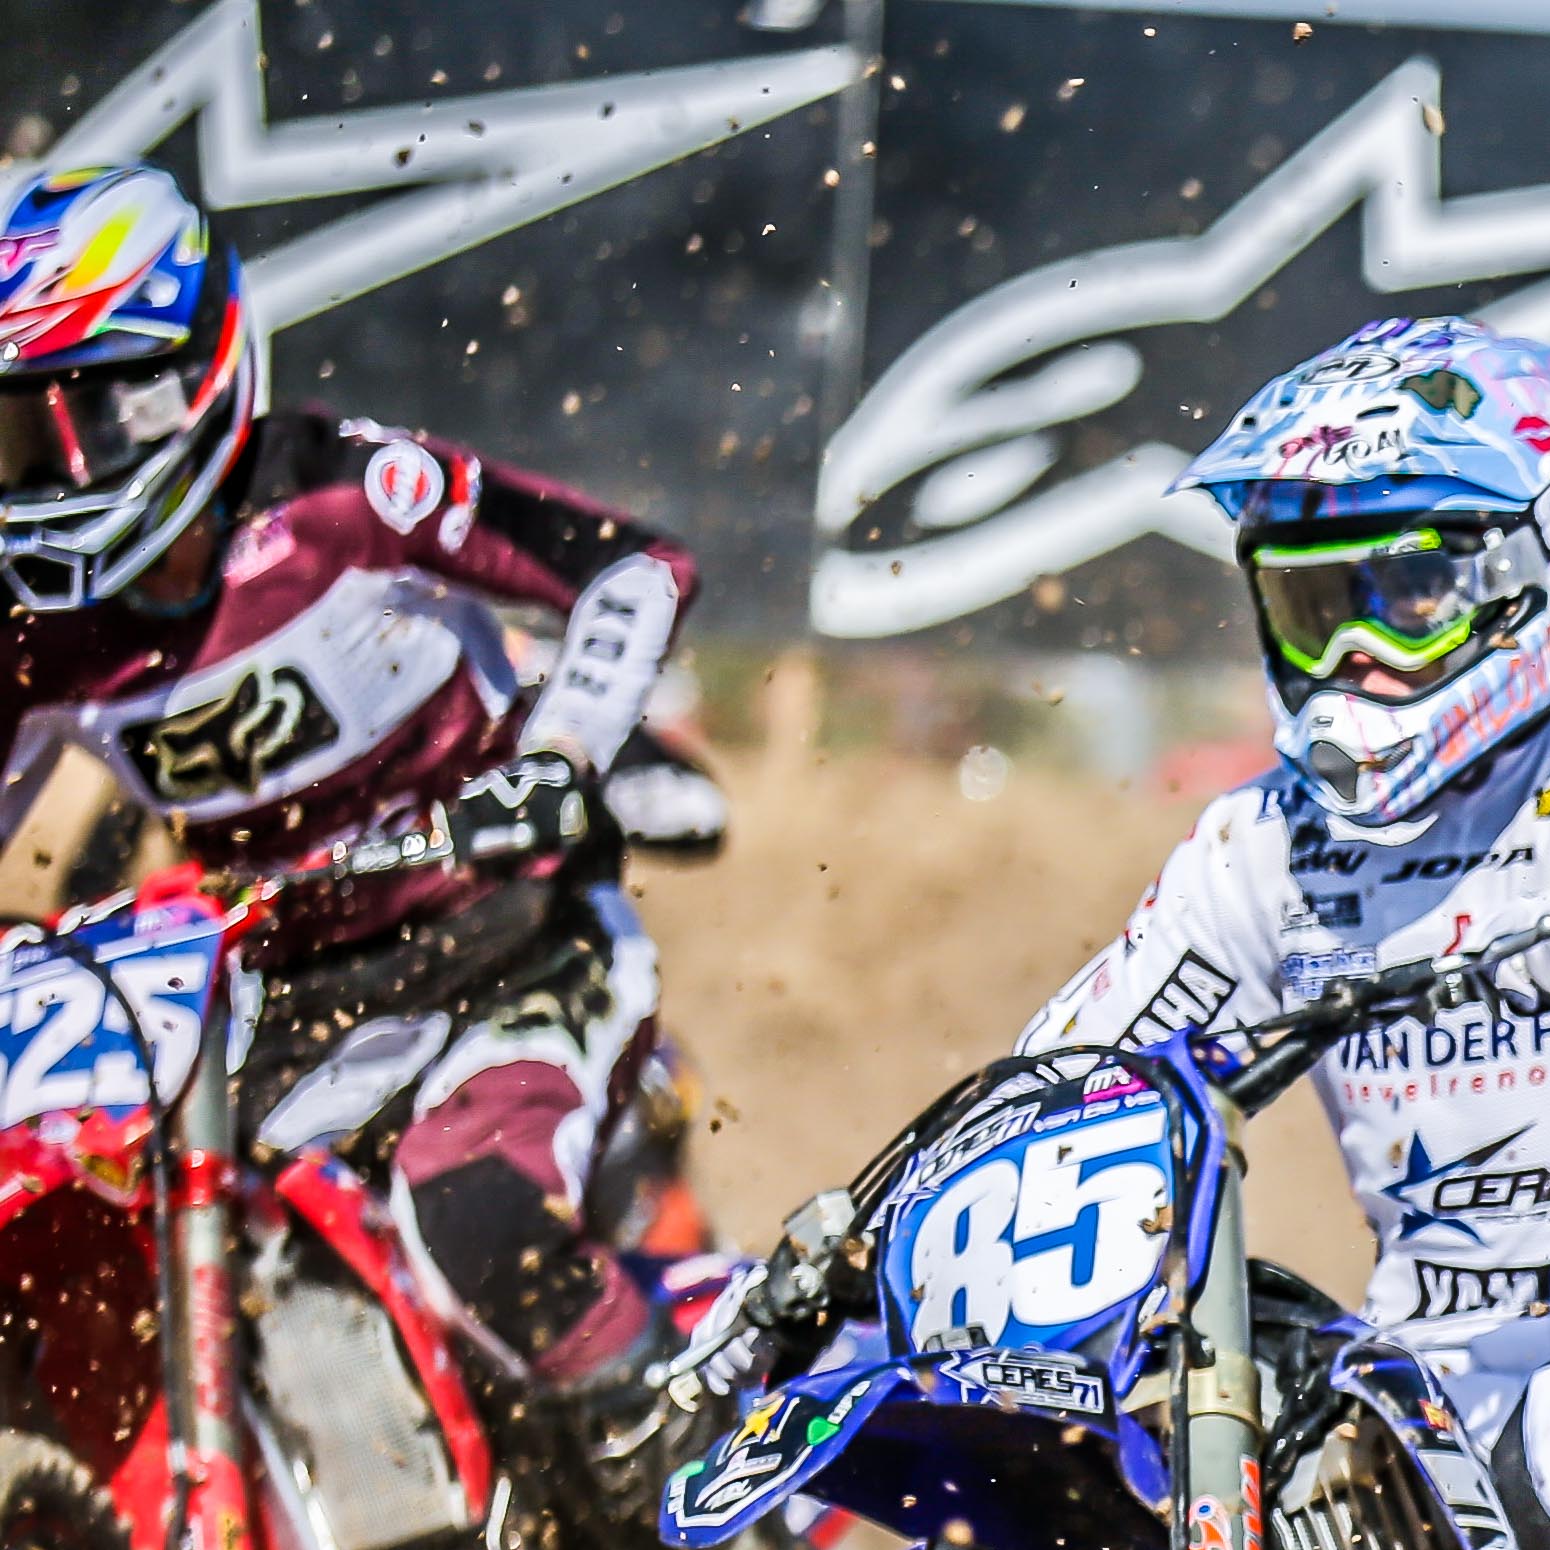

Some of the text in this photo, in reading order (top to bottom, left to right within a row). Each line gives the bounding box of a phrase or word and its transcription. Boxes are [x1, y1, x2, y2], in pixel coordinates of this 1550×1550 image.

[0, 951, 208, 1131] 25
[1425, 1018, 1517, 1068] DER
[911, 1107, 1169, 1354] 85
